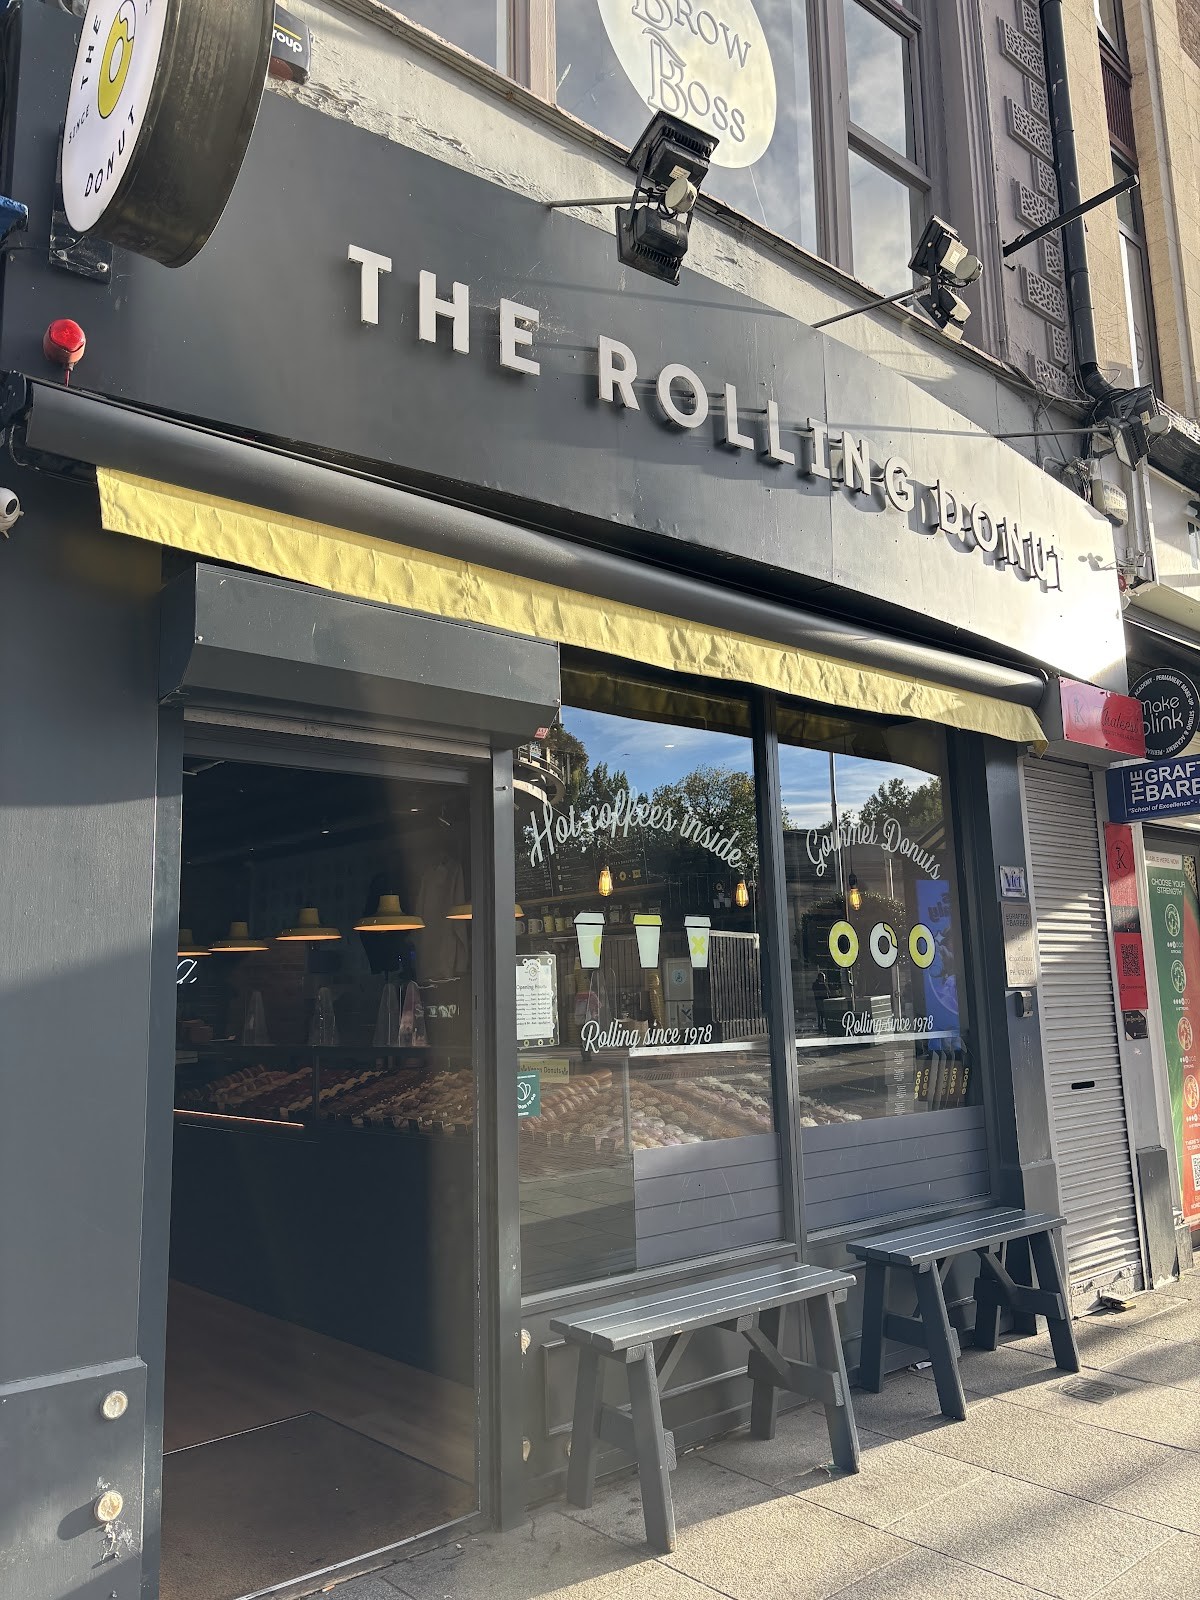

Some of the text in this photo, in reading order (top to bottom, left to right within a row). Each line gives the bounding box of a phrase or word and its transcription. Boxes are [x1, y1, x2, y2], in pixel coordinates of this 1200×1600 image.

[80, 15, 101, 90] THE
[69, 104, 90, 144] SINCE
[85, 105, 135, 198] DONUT
[348, 244, 1064, 592] THE ROLLING DONUT
[1156, 674, 1183, 687] PERMANENT
[1181, 683, 1195, 706] MAKE-UP
[1186, 710, 1195, 731] STUDIO
[1166, 734, 1186, 753] ACADEMY
[1130, 770, 1144, 804] THE
[1145, 761, 1200, 783] GRAF
[530, 786, 748, 868] Hot coffees inside
[806, 818, 941, 880] Gourmet Donuts
[1151, 878, 1186, 888] CHOOSE YOUR
[1157, 886, 1182, 895] STRENGTH
[581, 1019, 713, 1053] Rolling since 1978
[842, 1011, 934, 1037] Rolling since 1978
